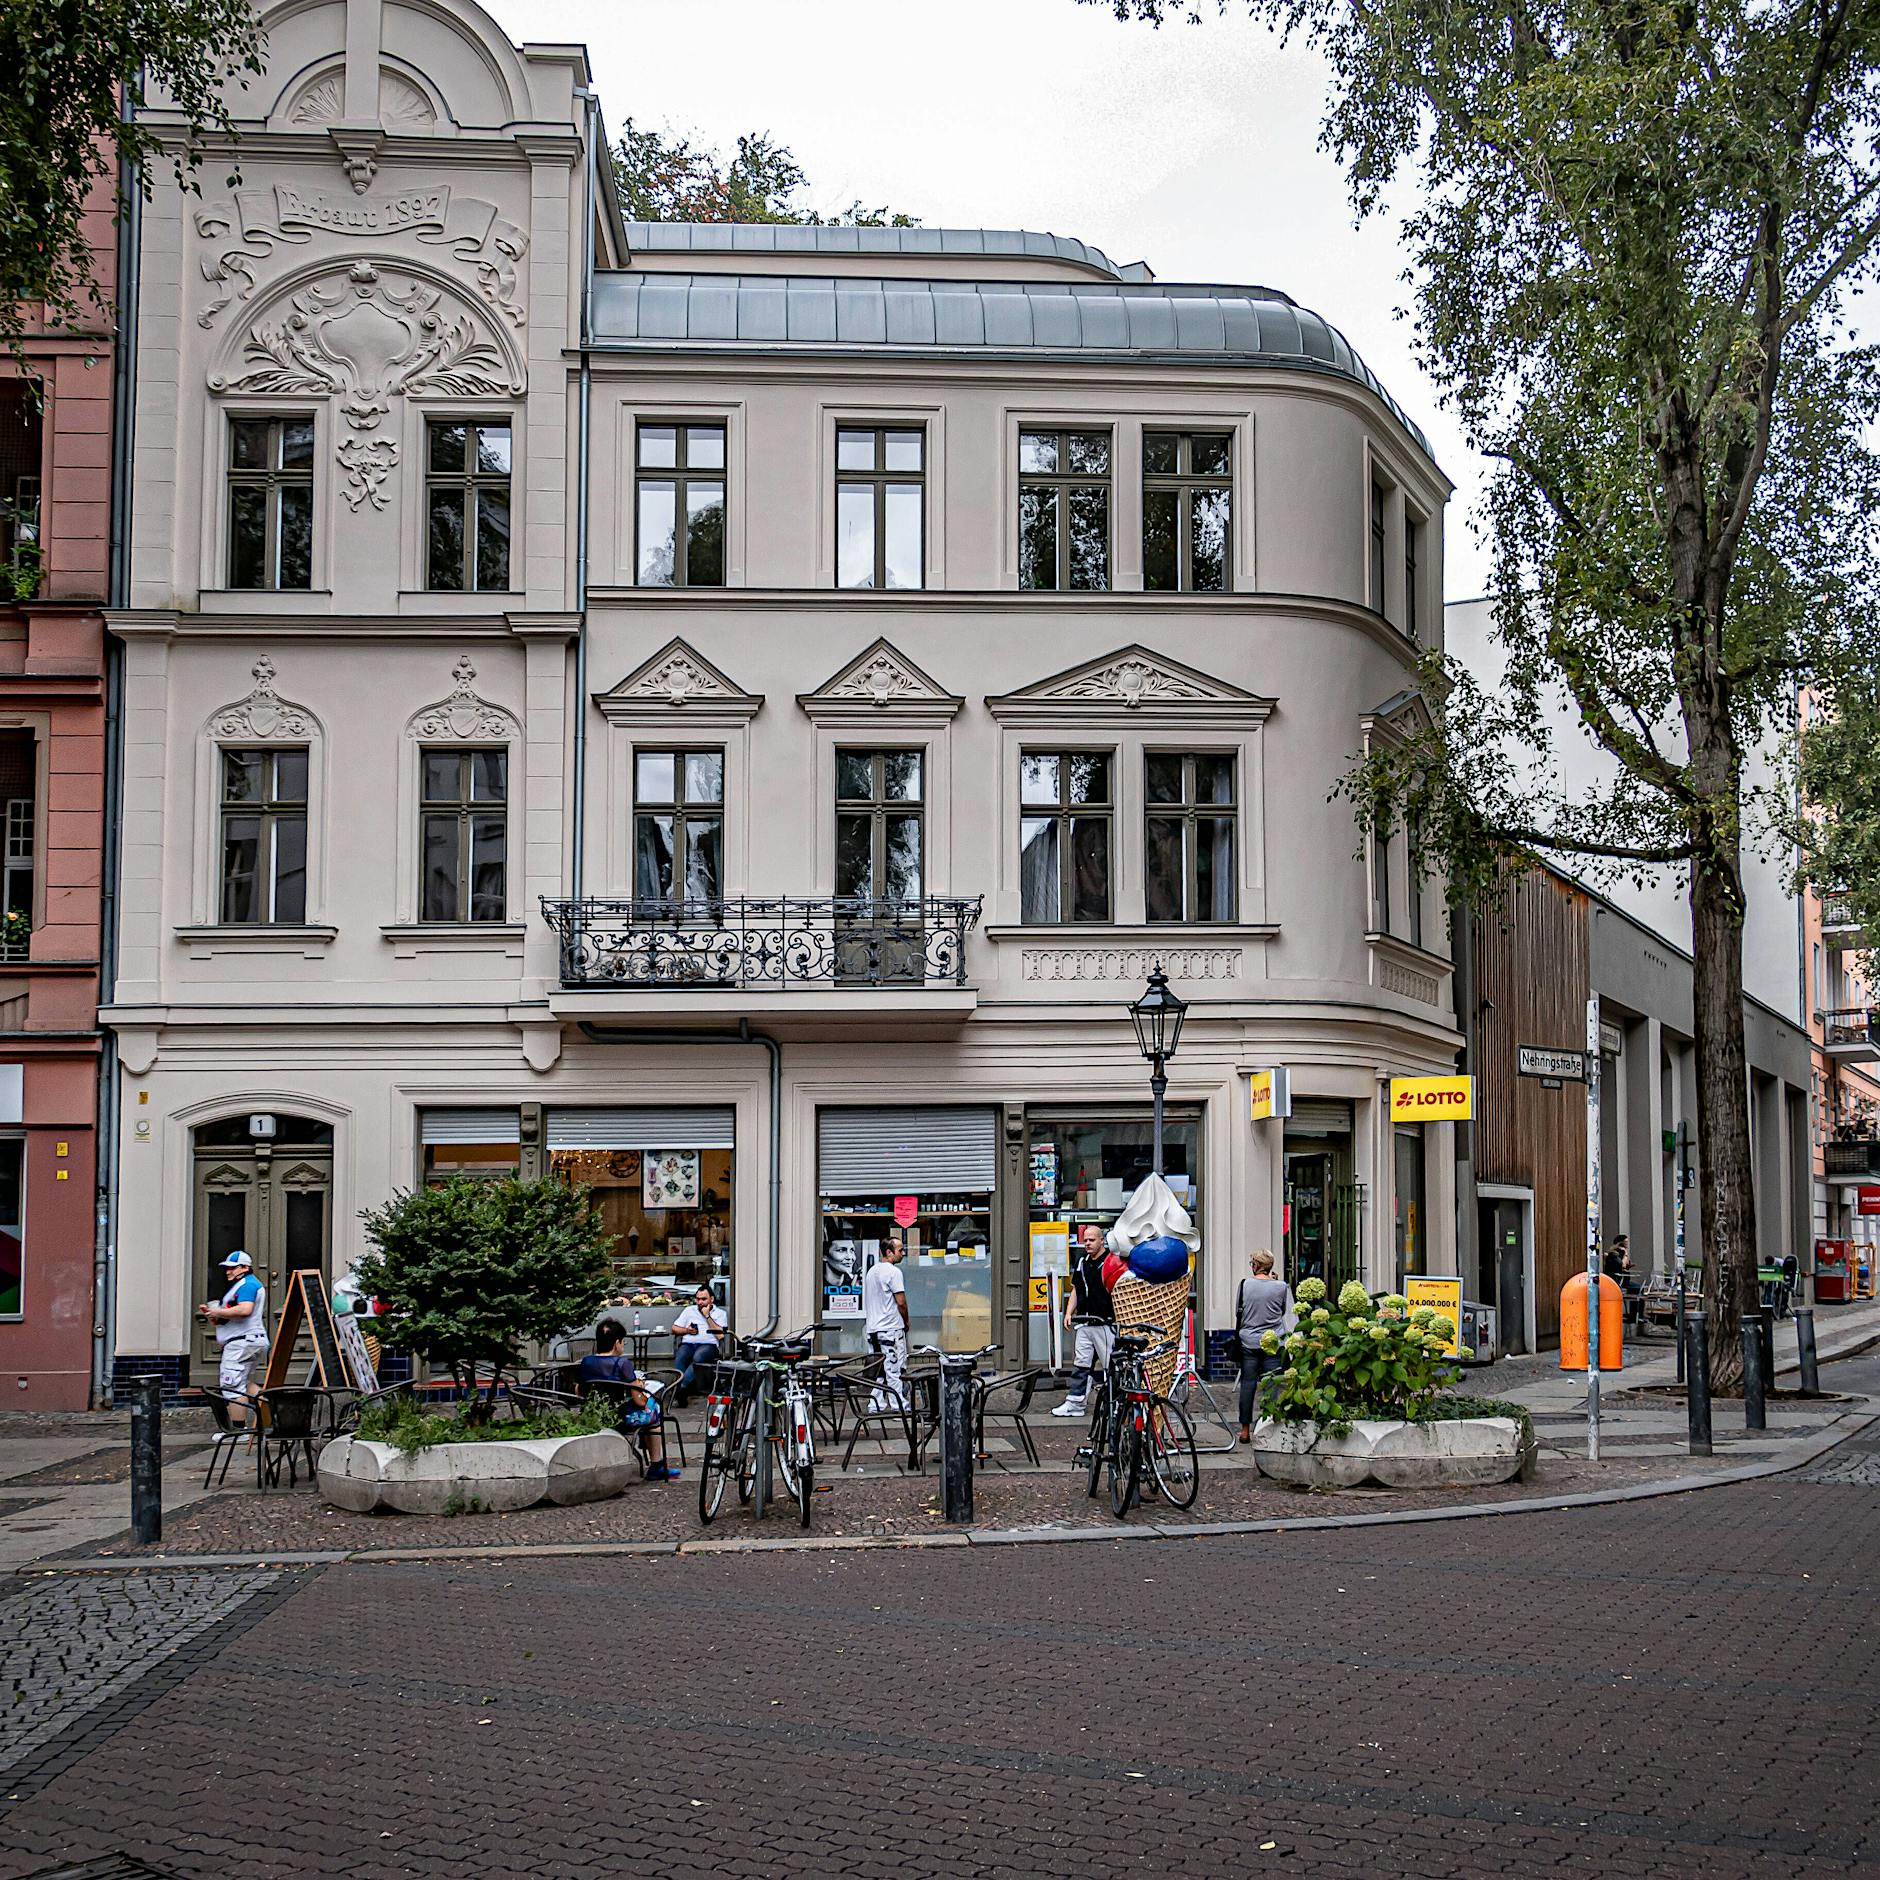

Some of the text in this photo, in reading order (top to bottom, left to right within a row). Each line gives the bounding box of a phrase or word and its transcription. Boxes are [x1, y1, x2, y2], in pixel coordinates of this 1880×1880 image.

[280, 189, 378, 228] Erbaut
[1521, 1050, 1581, 1073] Nehringstraße
[1416, 1091, 1466, 1106] LOTTO
[256, 1119, 263, 1132] 1
[823, 1285, 862, 1295] IQOS
